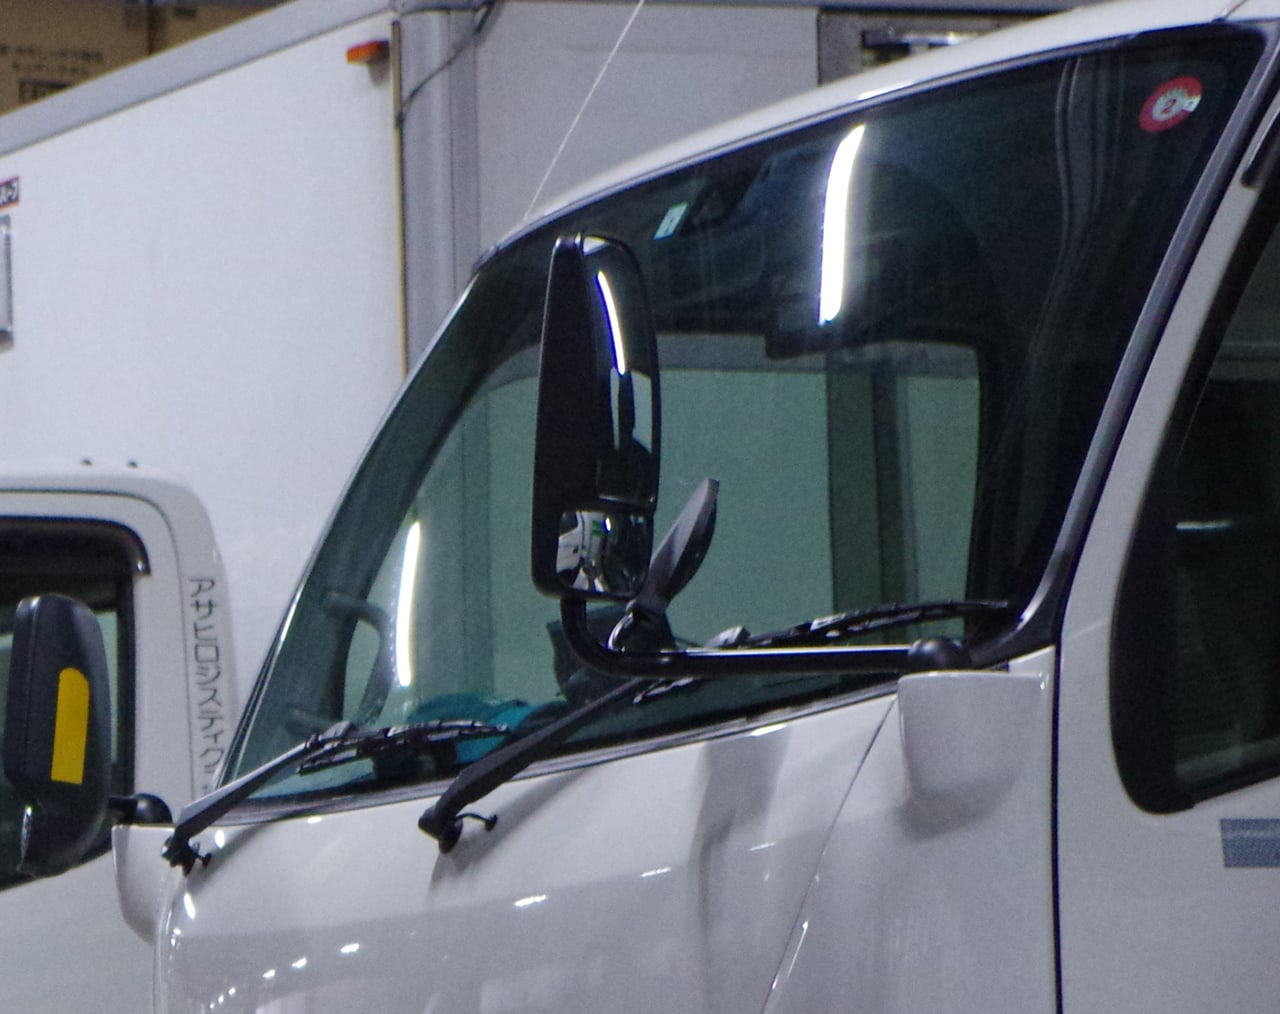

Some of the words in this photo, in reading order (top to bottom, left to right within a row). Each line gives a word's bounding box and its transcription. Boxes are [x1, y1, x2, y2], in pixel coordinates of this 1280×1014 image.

[189, 576, 226, 790] アサヒロジスティク
